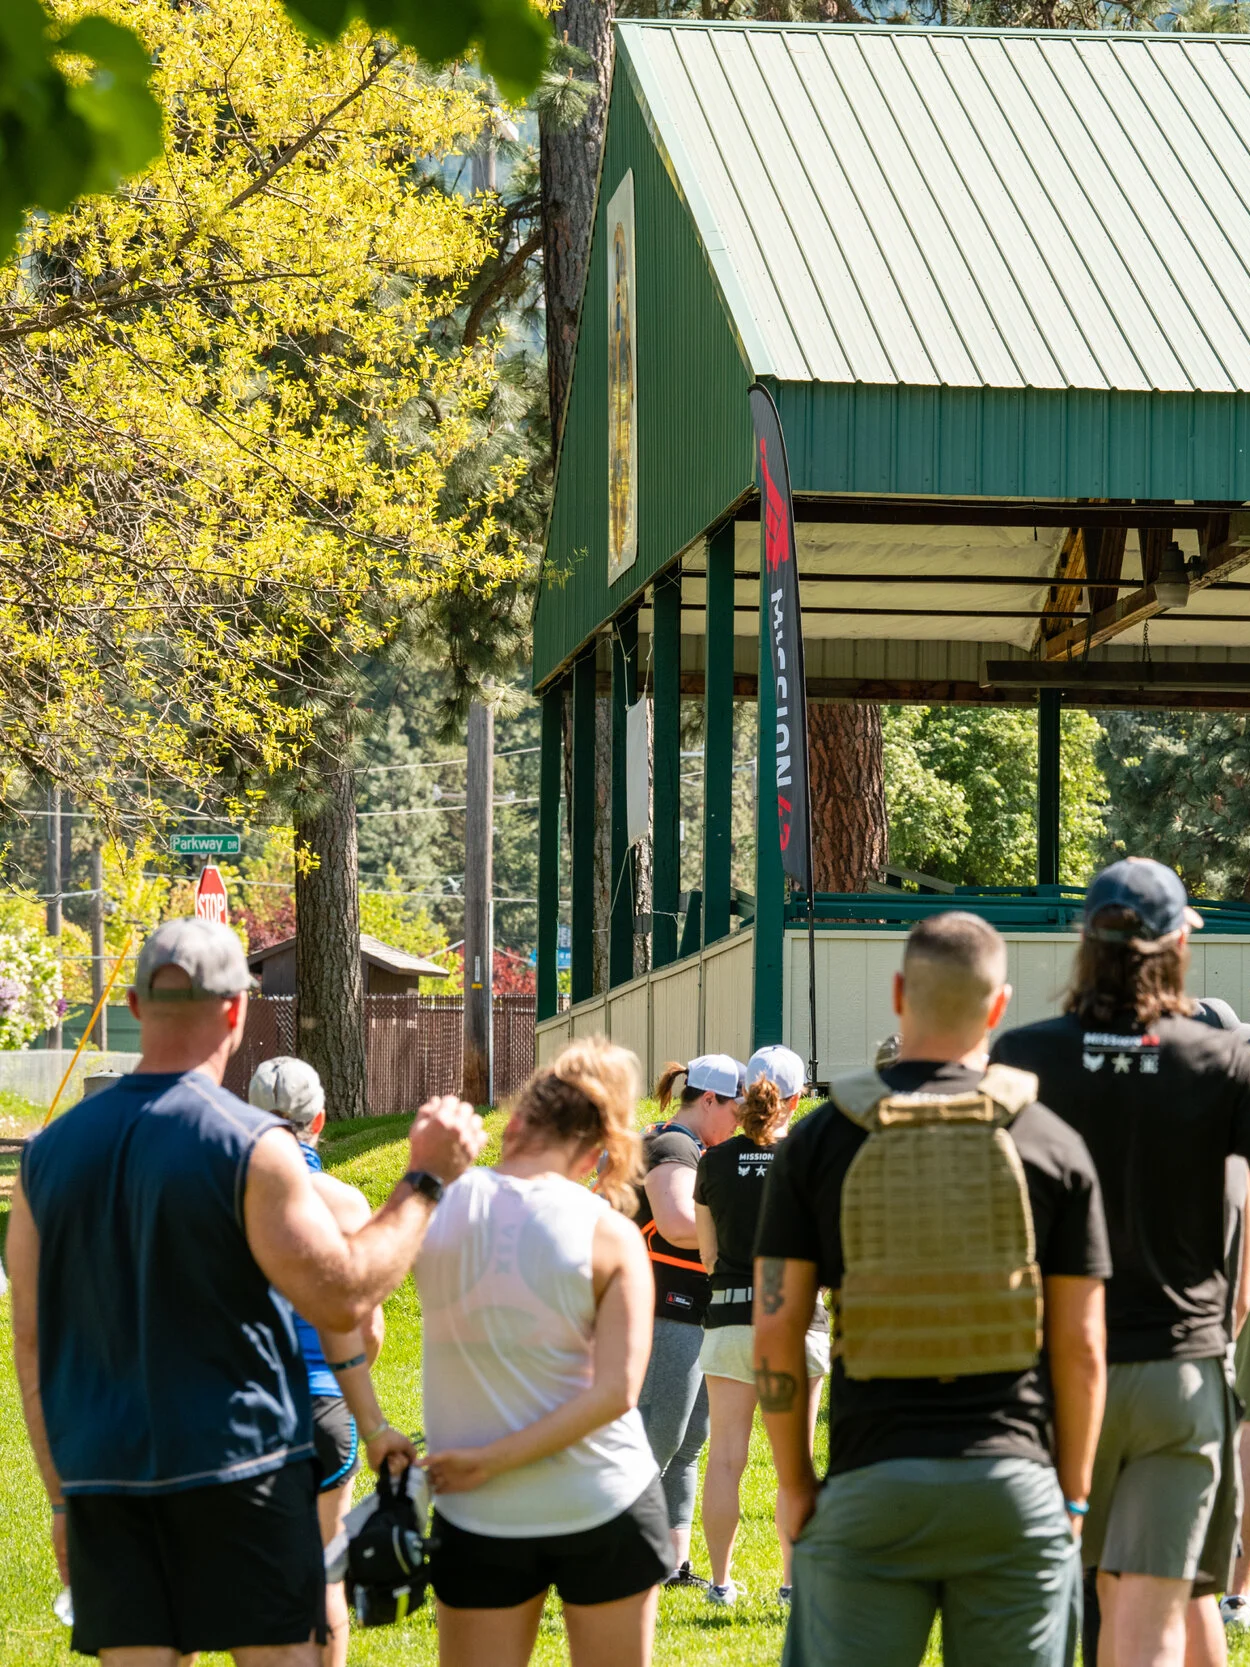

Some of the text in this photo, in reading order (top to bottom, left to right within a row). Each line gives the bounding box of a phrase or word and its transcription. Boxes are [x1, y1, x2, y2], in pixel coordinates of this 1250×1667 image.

[173, 837, 238, 853] Parkway DR
[198, 892, 225, 921] STOP
